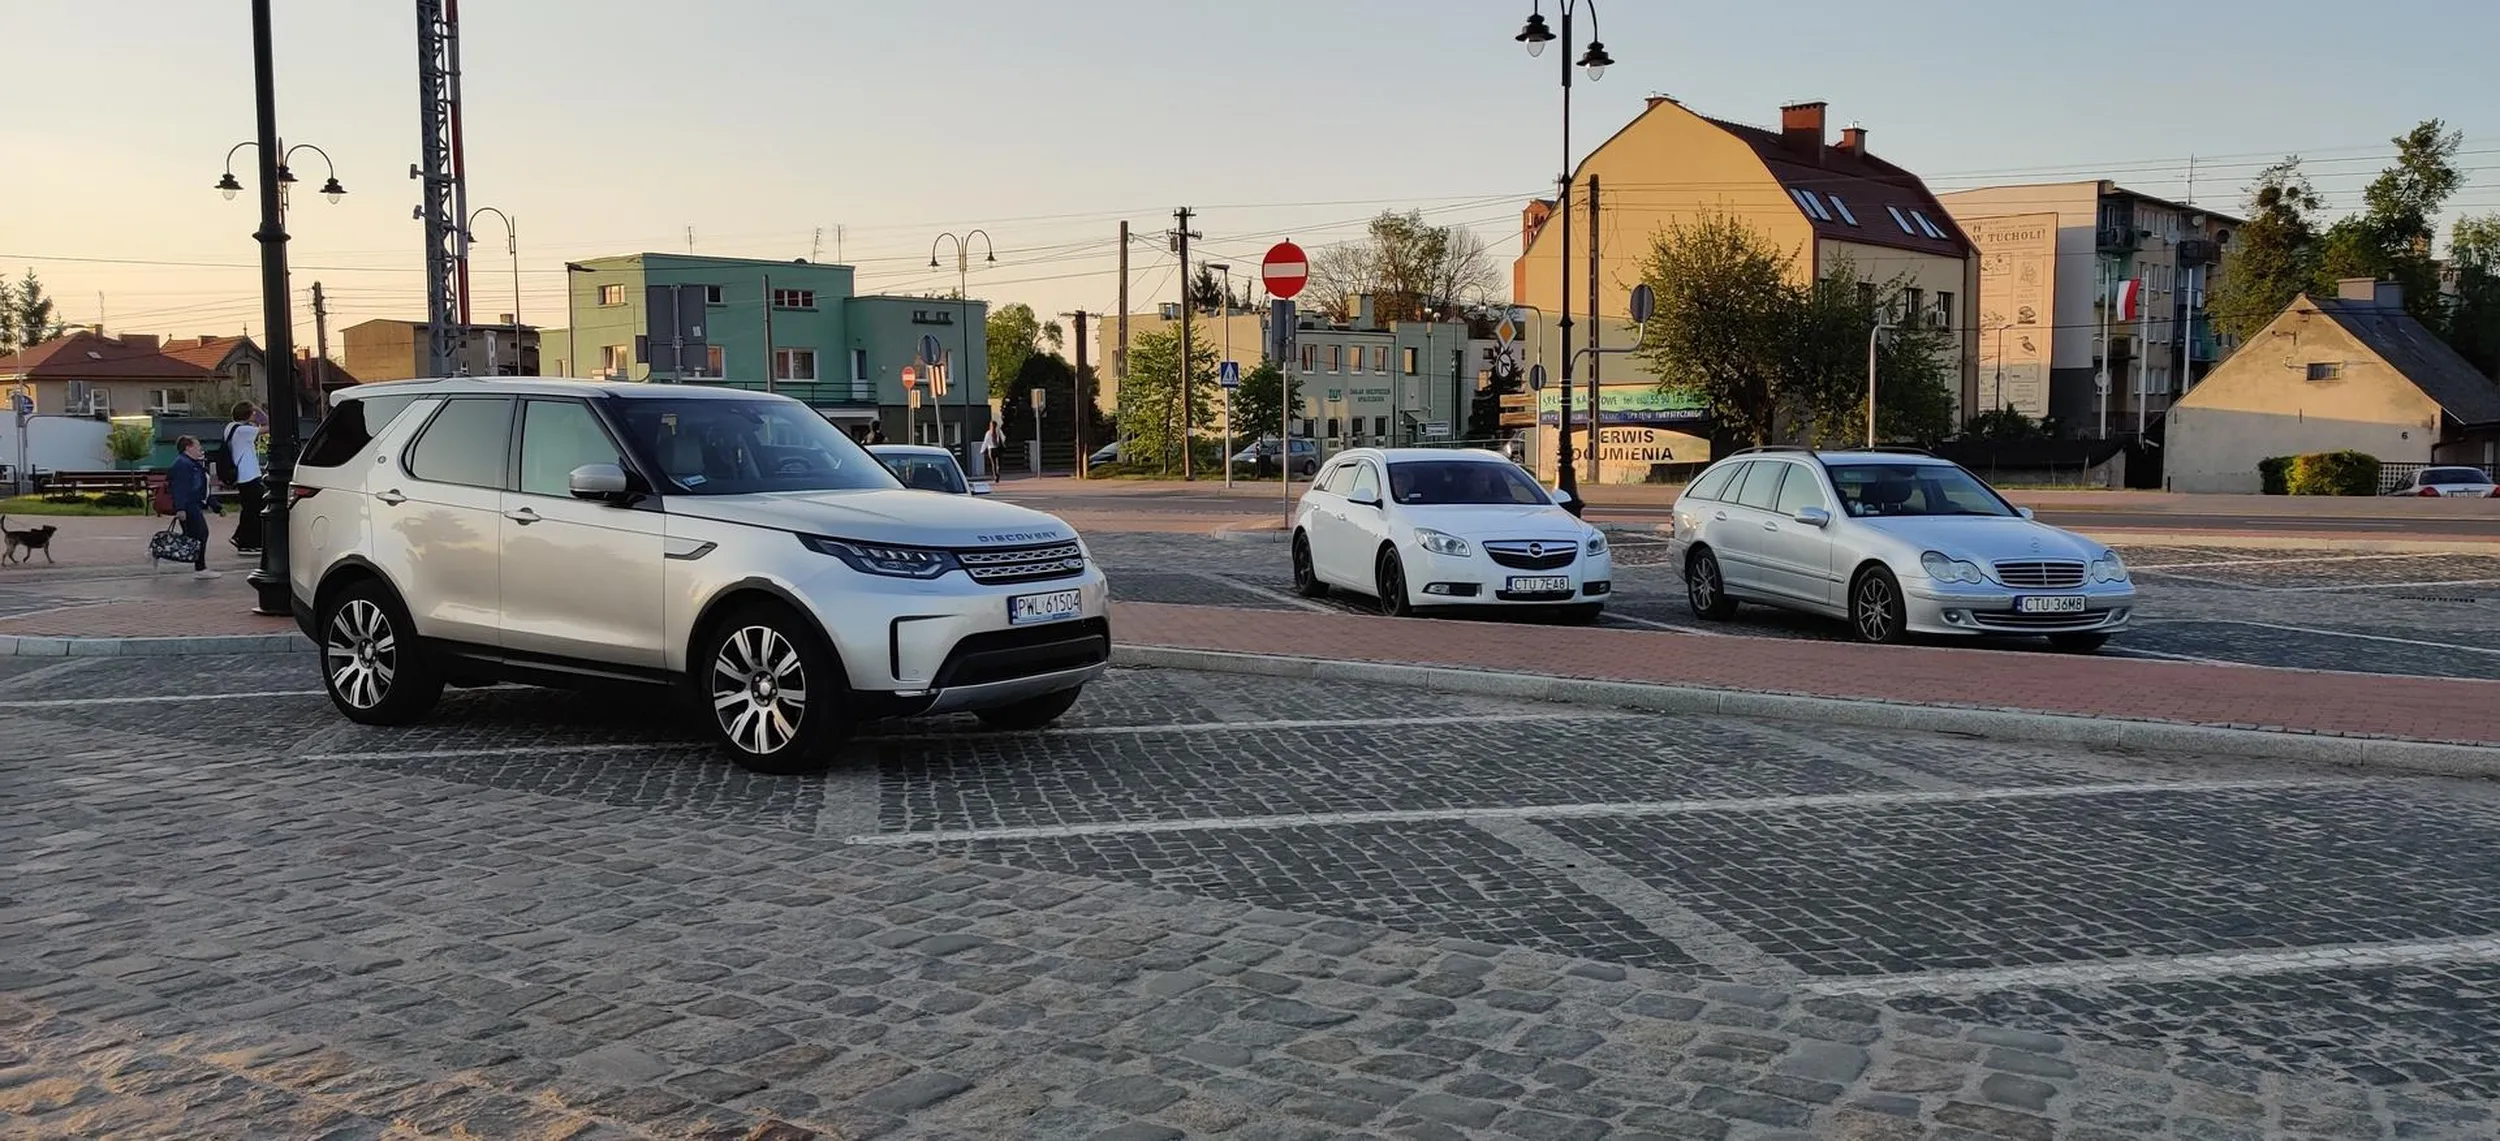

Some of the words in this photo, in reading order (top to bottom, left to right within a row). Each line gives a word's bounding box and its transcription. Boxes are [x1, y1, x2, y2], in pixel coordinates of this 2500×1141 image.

[1988, 229, 2046, 242] TUCHOLI!
[1600, 430, 1655, 444] ERWIS
[2401, 431, 2408, 440] 6
[977, 530, 1058, 543] DISCOVERY
[1514, 579, 1537, 590] CTU
[1018, 597, 1042, 617] PWL
[1046, 592, 1079, 613] 61504
[2025, 598, 2050, 611] CTU
